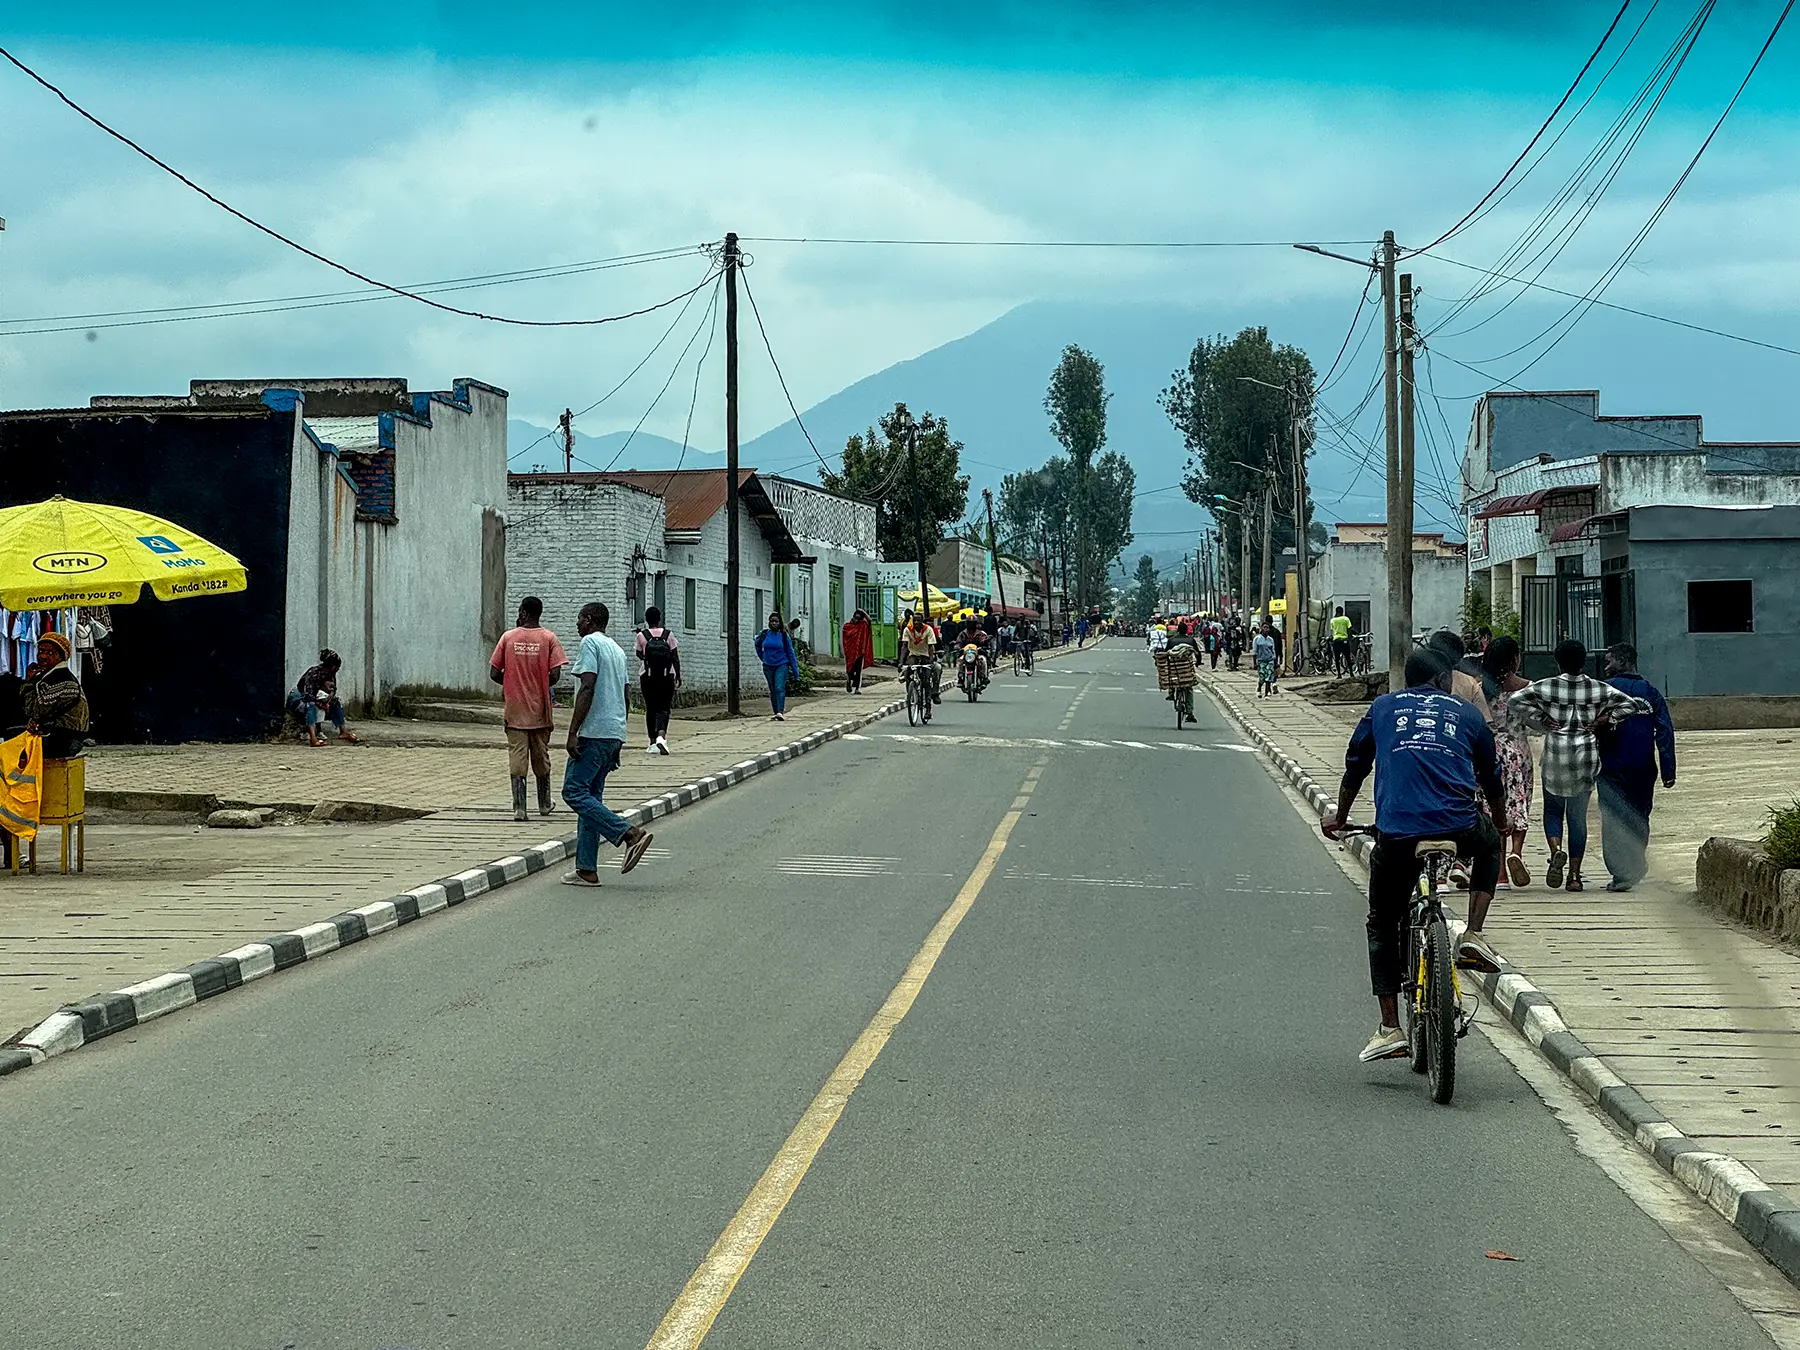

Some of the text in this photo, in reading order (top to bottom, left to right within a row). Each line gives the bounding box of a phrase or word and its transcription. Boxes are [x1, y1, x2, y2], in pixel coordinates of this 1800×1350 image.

[50, 558, 89, 568] MTN
[161, 557, 206, 569] MoMo
[171, 582, 200, 594] Kanda
[26, 590, 123, 604] everywhere you go
